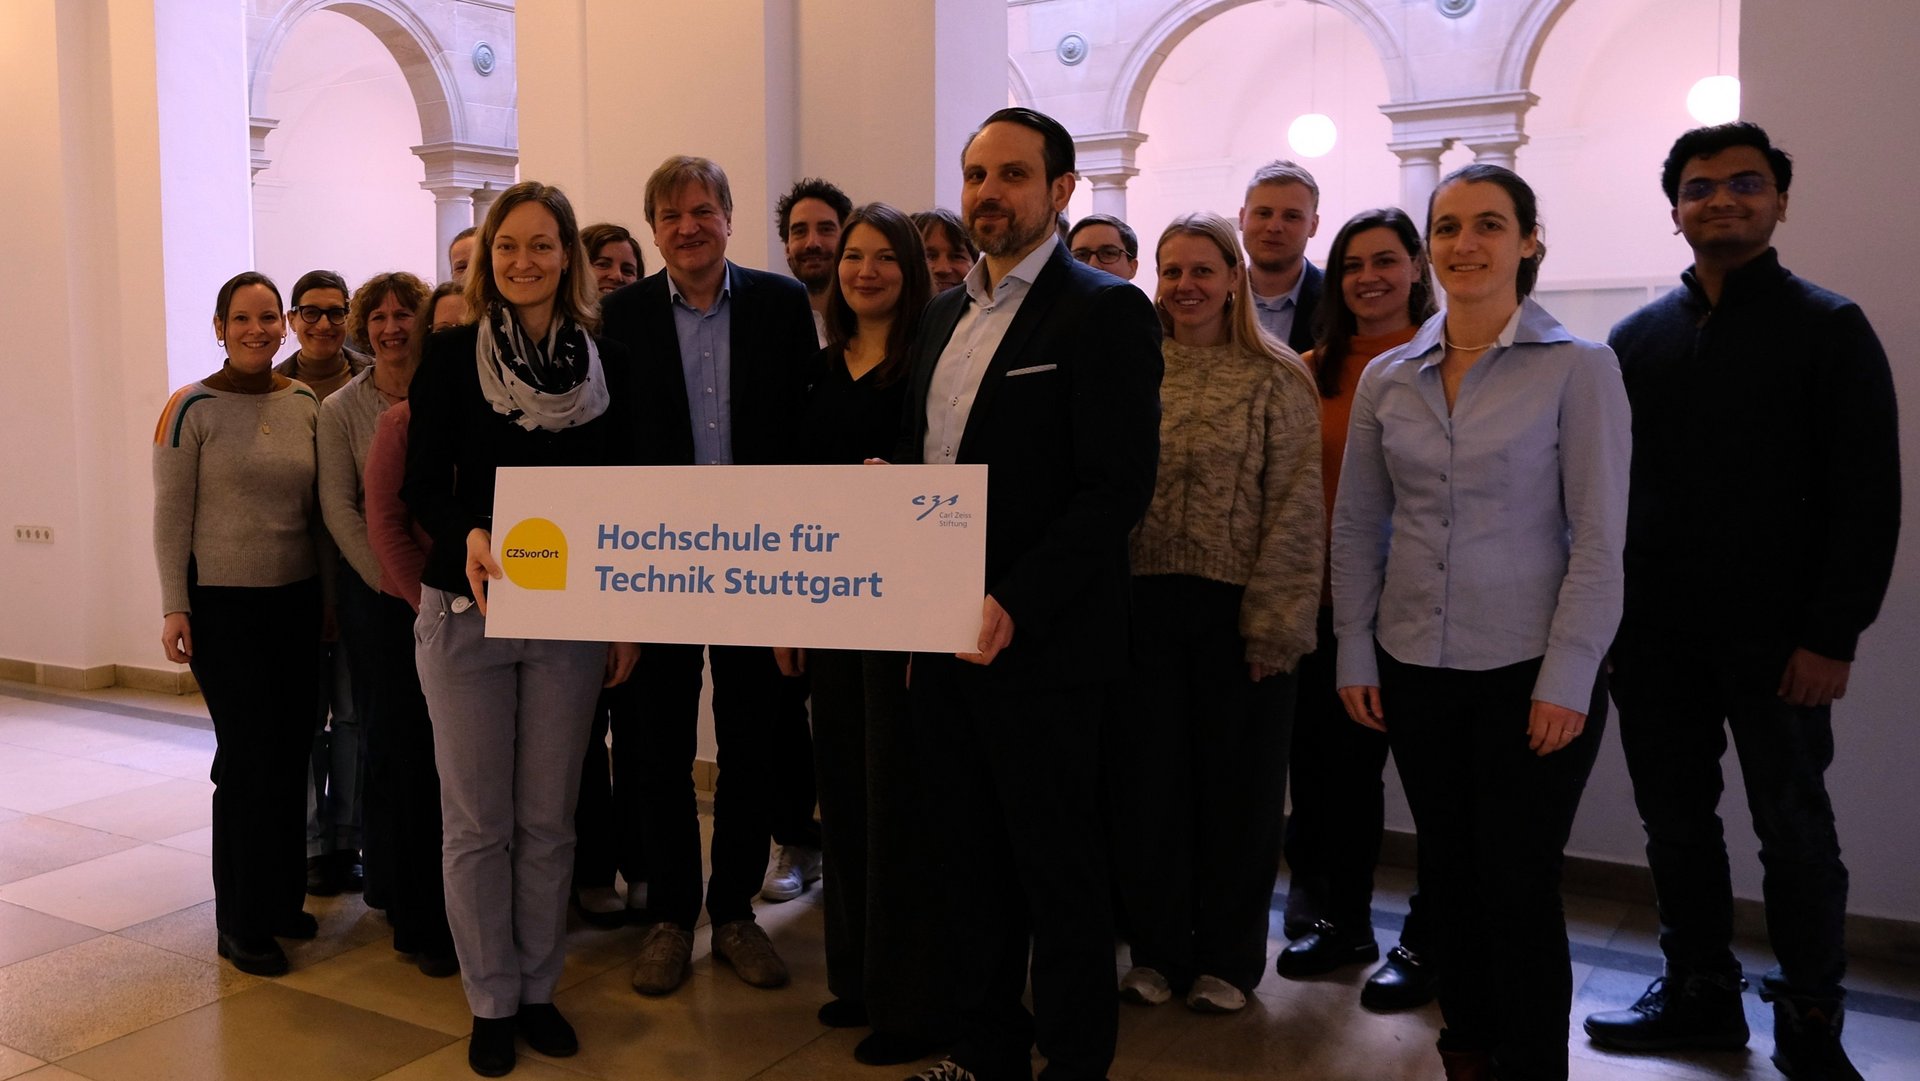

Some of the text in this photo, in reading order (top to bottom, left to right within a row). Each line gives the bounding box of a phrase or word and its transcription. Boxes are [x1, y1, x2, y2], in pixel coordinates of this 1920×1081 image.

[939, 511, 953, 519] Carl
[939, 520, 968, 529] Stiftung
[597, 523, 840, 553] Hochschule für
[505, 548, 559, 558] CZSvorOrt
[595, 565, 883, 603] Technik Stuttgart
